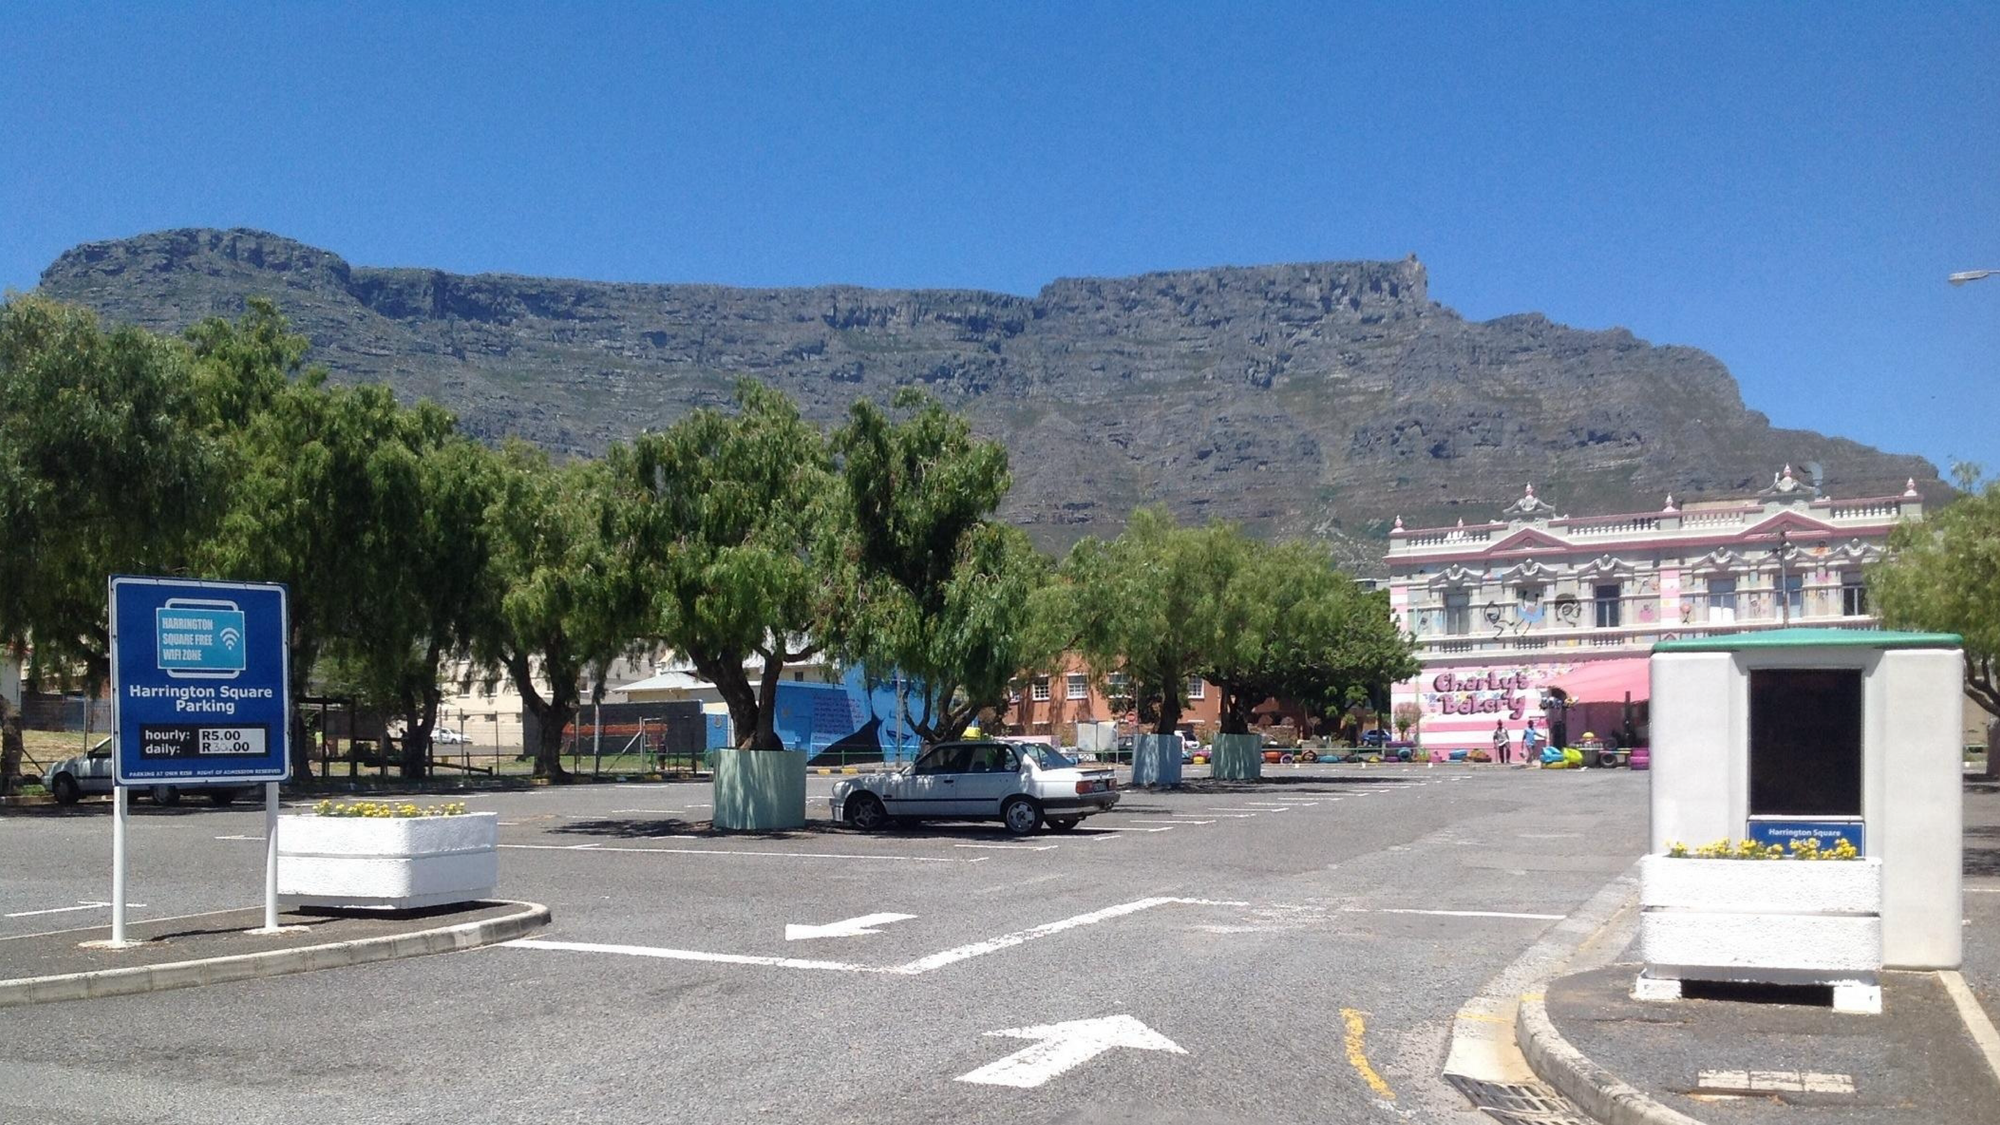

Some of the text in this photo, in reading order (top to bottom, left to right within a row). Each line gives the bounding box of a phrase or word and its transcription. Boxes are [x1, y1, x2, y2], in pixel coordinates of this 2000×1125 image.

[162, 617, 214, 631] HARRINGTON
[162, 632, 213, 646] SQUARE FREE
[162, 648, 203, 661] WIFI ZONE
[129, 685, 273, 700] Harrington Square
[176, 700, 235, 715] Parking
[145, 729, 241, 742] hourly: R5.00
[145, 743, 181, 756] daily:
[1768, 828, 1842, 837] Harrington Square
